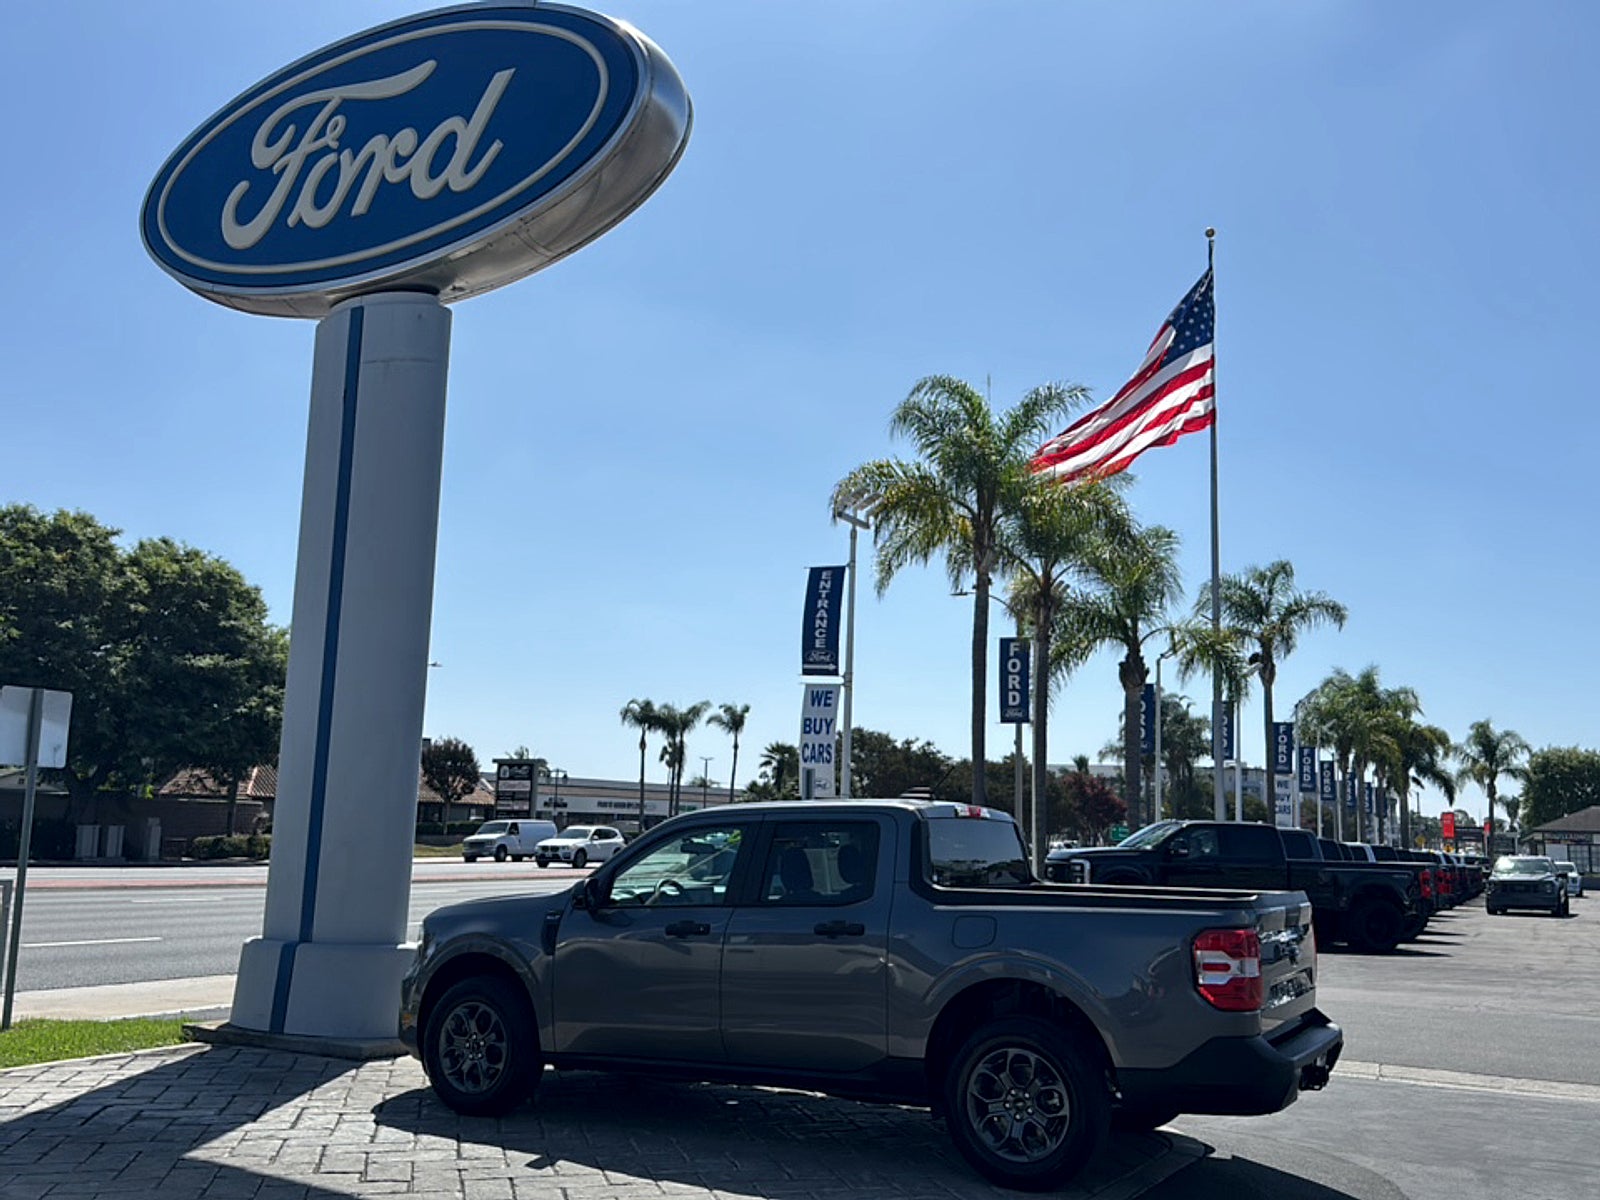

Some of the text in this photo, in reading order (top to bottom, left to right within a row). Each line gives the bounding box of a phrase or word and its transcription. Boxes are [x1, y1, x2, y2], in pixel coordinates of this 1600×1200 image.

[221, 59, 516, 250] Ford
[815, 570, 831, 649] ENTRANCE
[1007, 642, 1021, 707] FORD
[810, 689, 833, 708] WE
[803, 718, 834, 735] BUY
[802, 743, 833, 765] CARS
[1278, 725, 1287, 763] FORD
[1303, 748, 1311, 782] FORD
[1323, 762, 1331, 793] FORD
